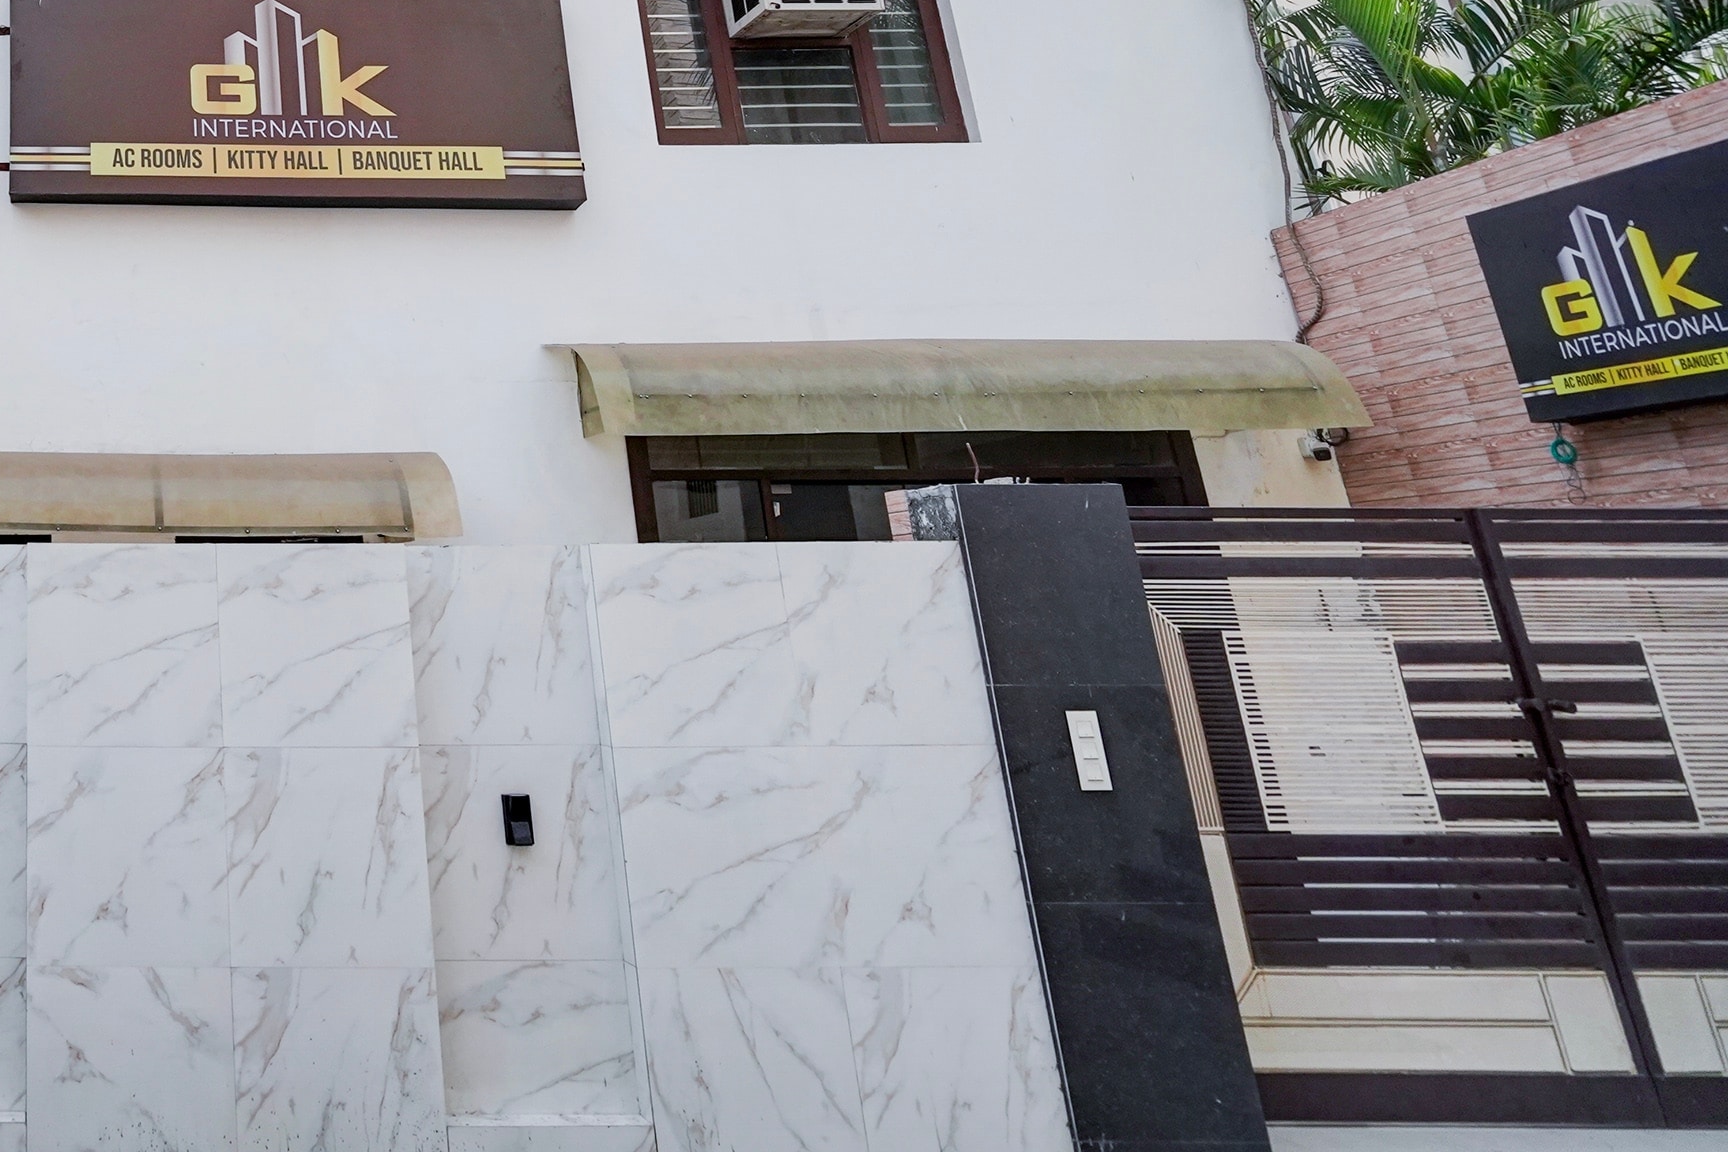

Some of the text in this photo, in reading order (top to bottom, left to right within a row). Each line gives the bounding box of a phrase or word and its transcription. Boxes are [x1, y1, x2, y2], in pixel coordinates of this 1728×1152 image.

[192, 118, 399, 140] INTERNATIONAL
[112, 148, 484, 172] AC ROOMS KITTY HALL BANQUET HALL
[1558, 311, 1728, 360] INTERNATIONAL
[1563, 377, 1575, 389] AC
[1577, 372, 1608, 387] ROOMS
[1616, 366, 1643, 381] KITTY
[1646, 362, 1671, 377] HALL
[1679, 352, 1726, 371] BANQUET
